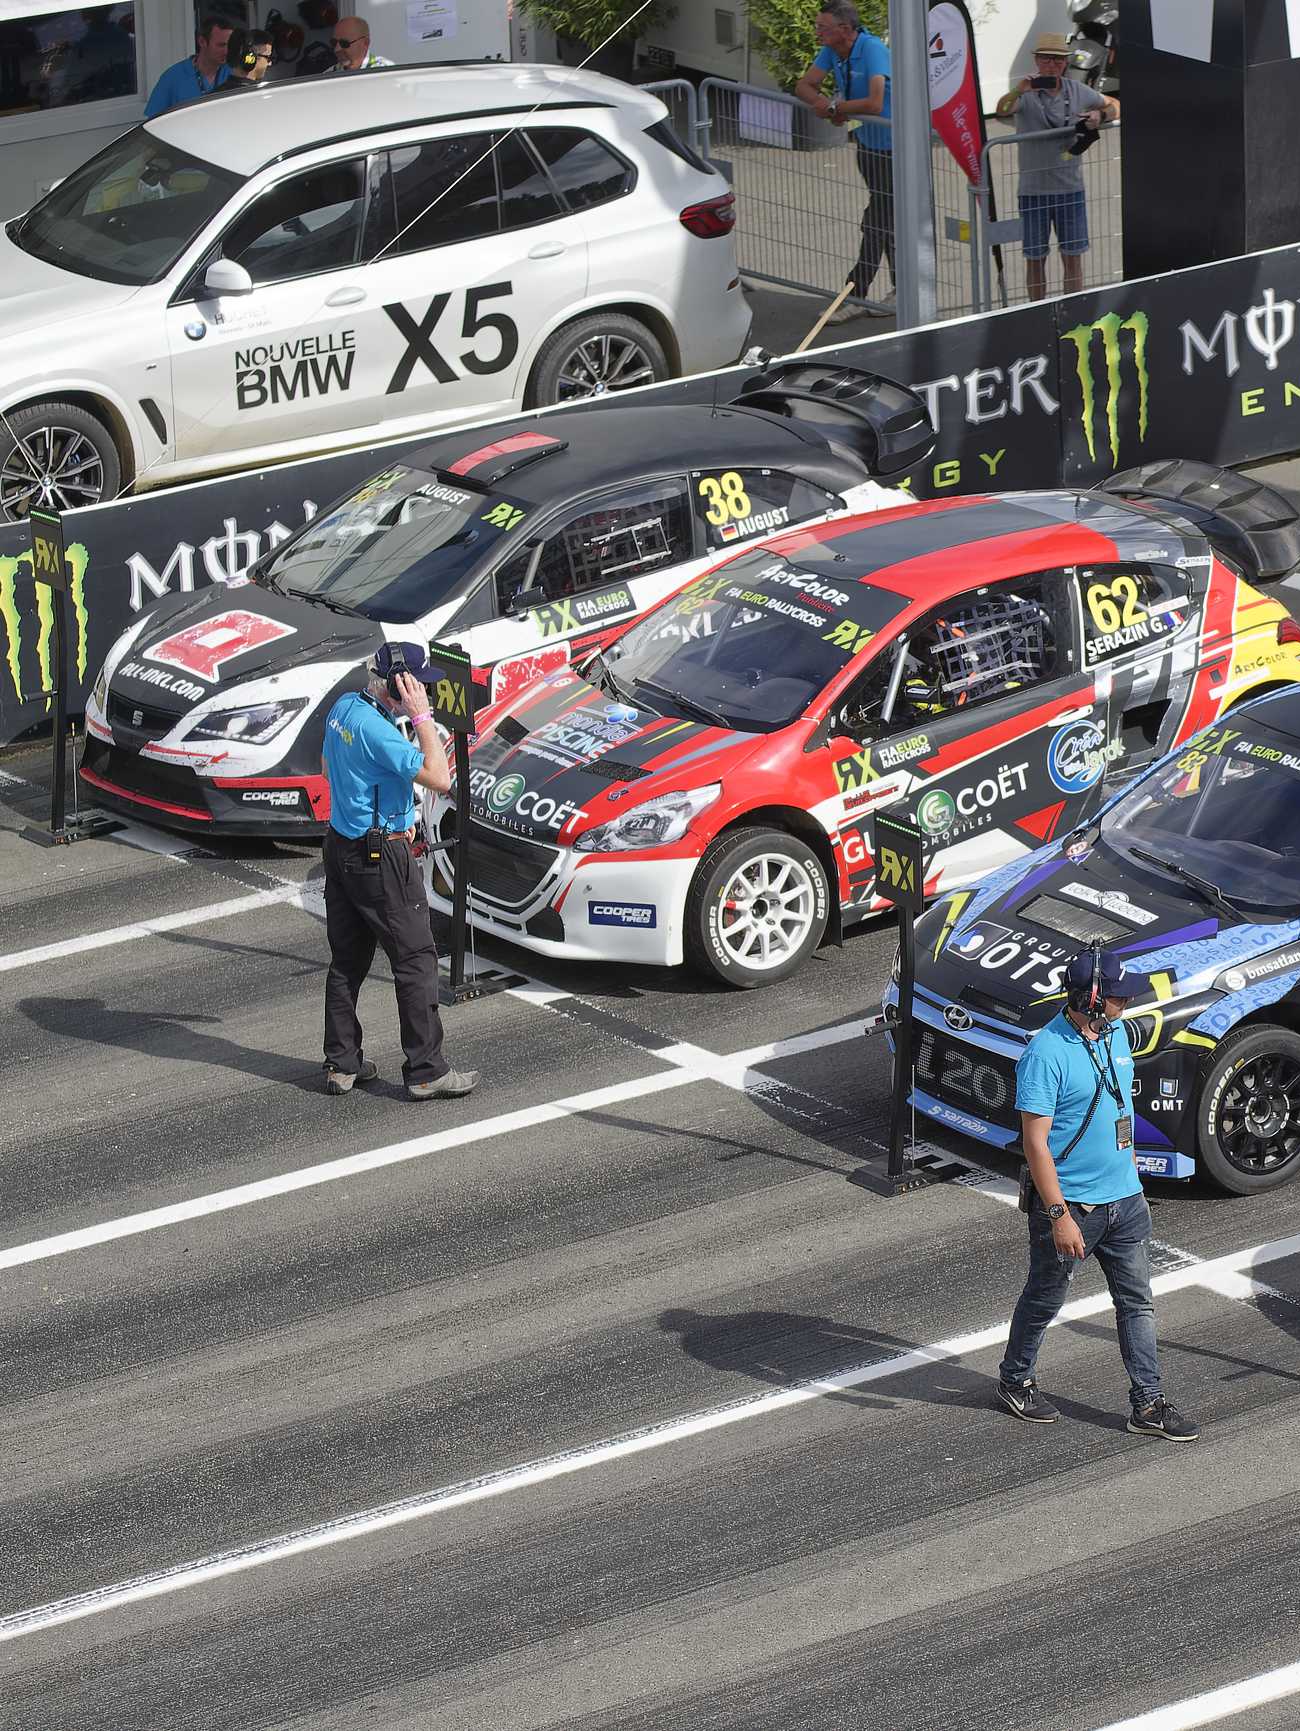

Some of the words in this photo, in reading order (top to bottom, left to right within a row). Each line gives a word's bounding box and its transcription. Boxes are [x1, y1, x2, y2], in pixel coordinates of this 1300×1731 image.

[235, 330, 356, 370] NOUVELLE
[382, 281, 519, 395] X5
[236, 351, 356, 410] BMW
[415, 483, 471, 505] AUGUST
[698, 471, 751, 525] 38
[737, 506, 790, 537] AUGUST
[579, 598, 630, 619] RALLYCROSS
[724, 587, 742, 600] FIA
[739, 591, 769, 606] EURO
[764, 599, 827, 628] RALLYCROSS
[1086, 576, 1149, 634] 62
[1086, 622, 1150, 658] SERAZIN
[1150, 617, 1169, 634] G.
[538, 721, 616, 759] PISCINE
[882, 743, 932, 769] RALLYCROSS
[1233, 741, 1253, 755] FIA
[1250, 745, 1283, 762] EURO
[242, 791, 300, 802] COOPER
[957, 762, 1029, 815] COËT
[470, 803, 534, 837] TOMOBILES
[514, 790, 589, 834] COËT
[803, 859, 825, 920] COOPER
[593, 905, 652, 918] COOPER
[621, 914, 651, 924] TIRES
[709, 905, 731, 967] COOPER
[1012, 932, 1078, 962] GROU
[979, 942, 1068, 994] OTS
[1151, 1099, 1184, 1112] OMT
[1208, 1066, 1234, 1136] COOPER
[1136, 1156, 1168, 1166] PER
